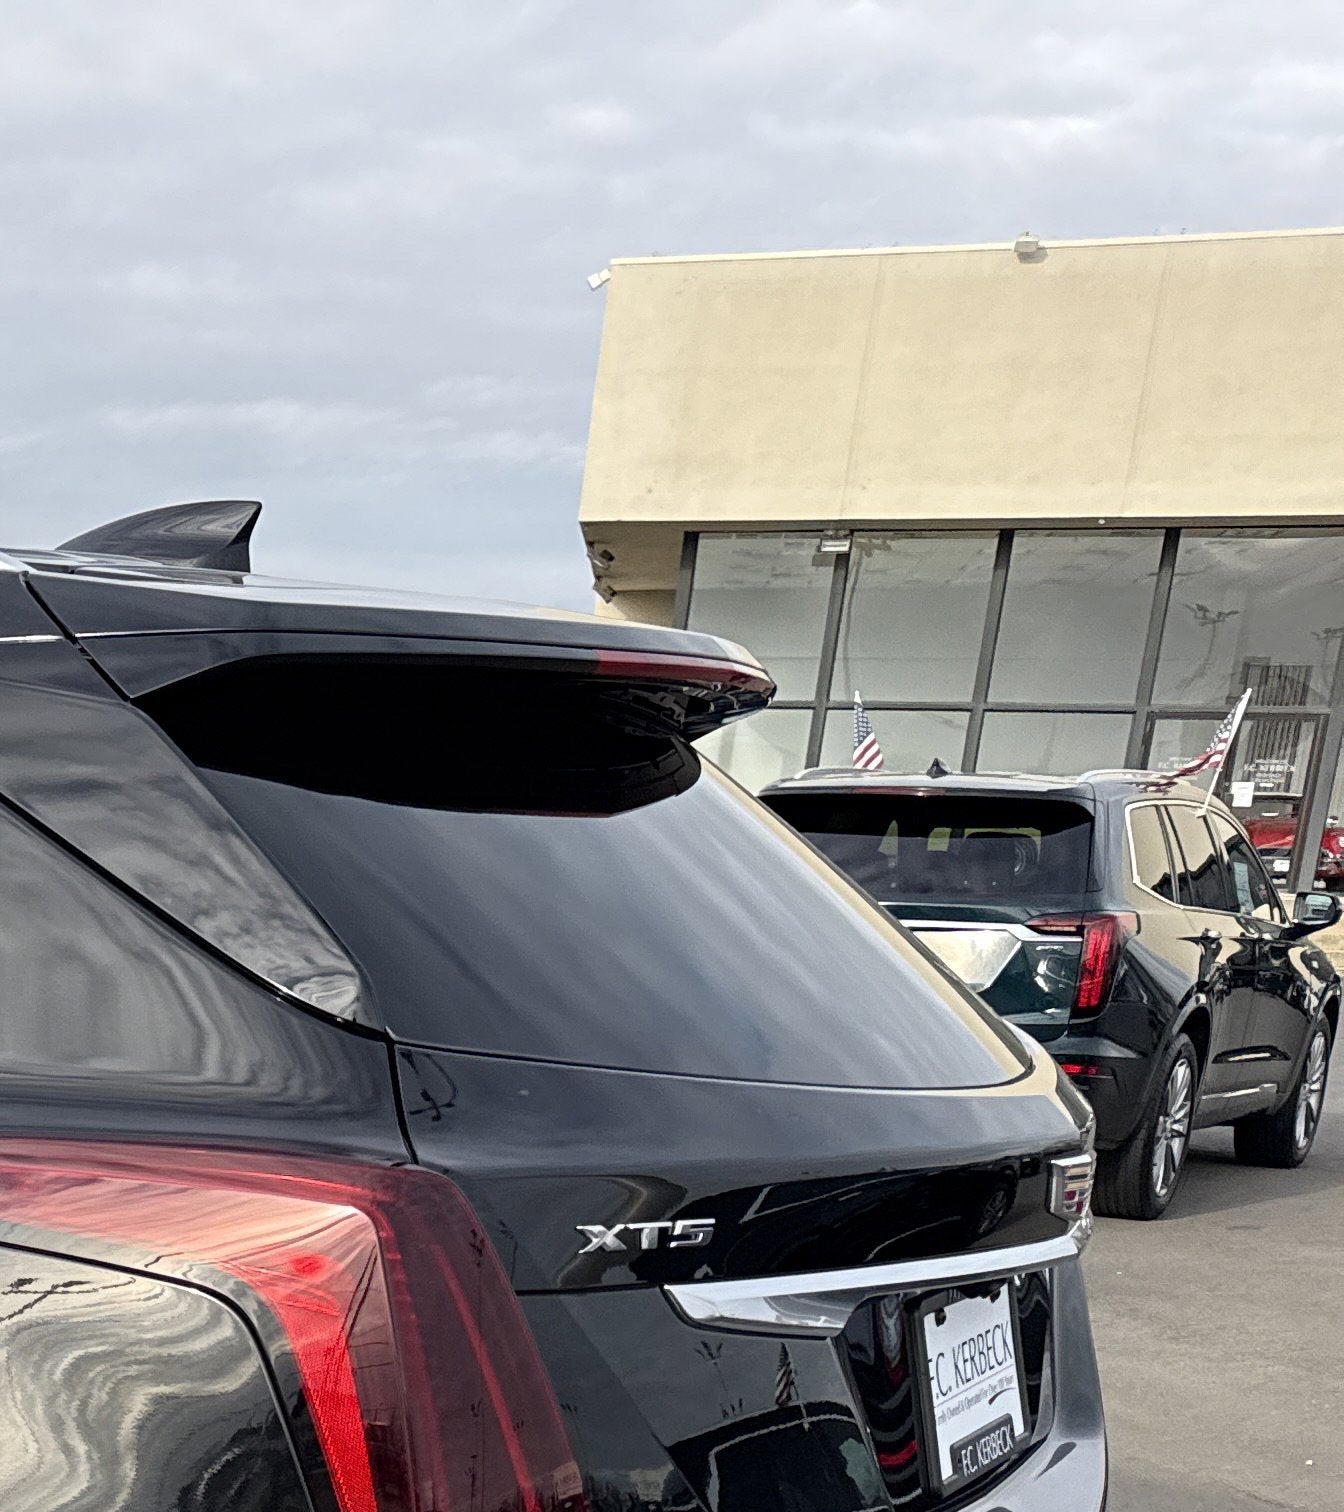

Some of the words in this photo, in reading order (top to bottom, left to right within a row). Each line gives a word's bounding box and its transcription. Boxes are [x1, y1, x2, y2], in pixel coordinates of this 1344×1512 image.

[576, 1218, 716, 1254] XT5
[952, 1321, 1013, 1389] KERBECK
[975, 1423, 1014, 1469] KERBECK
